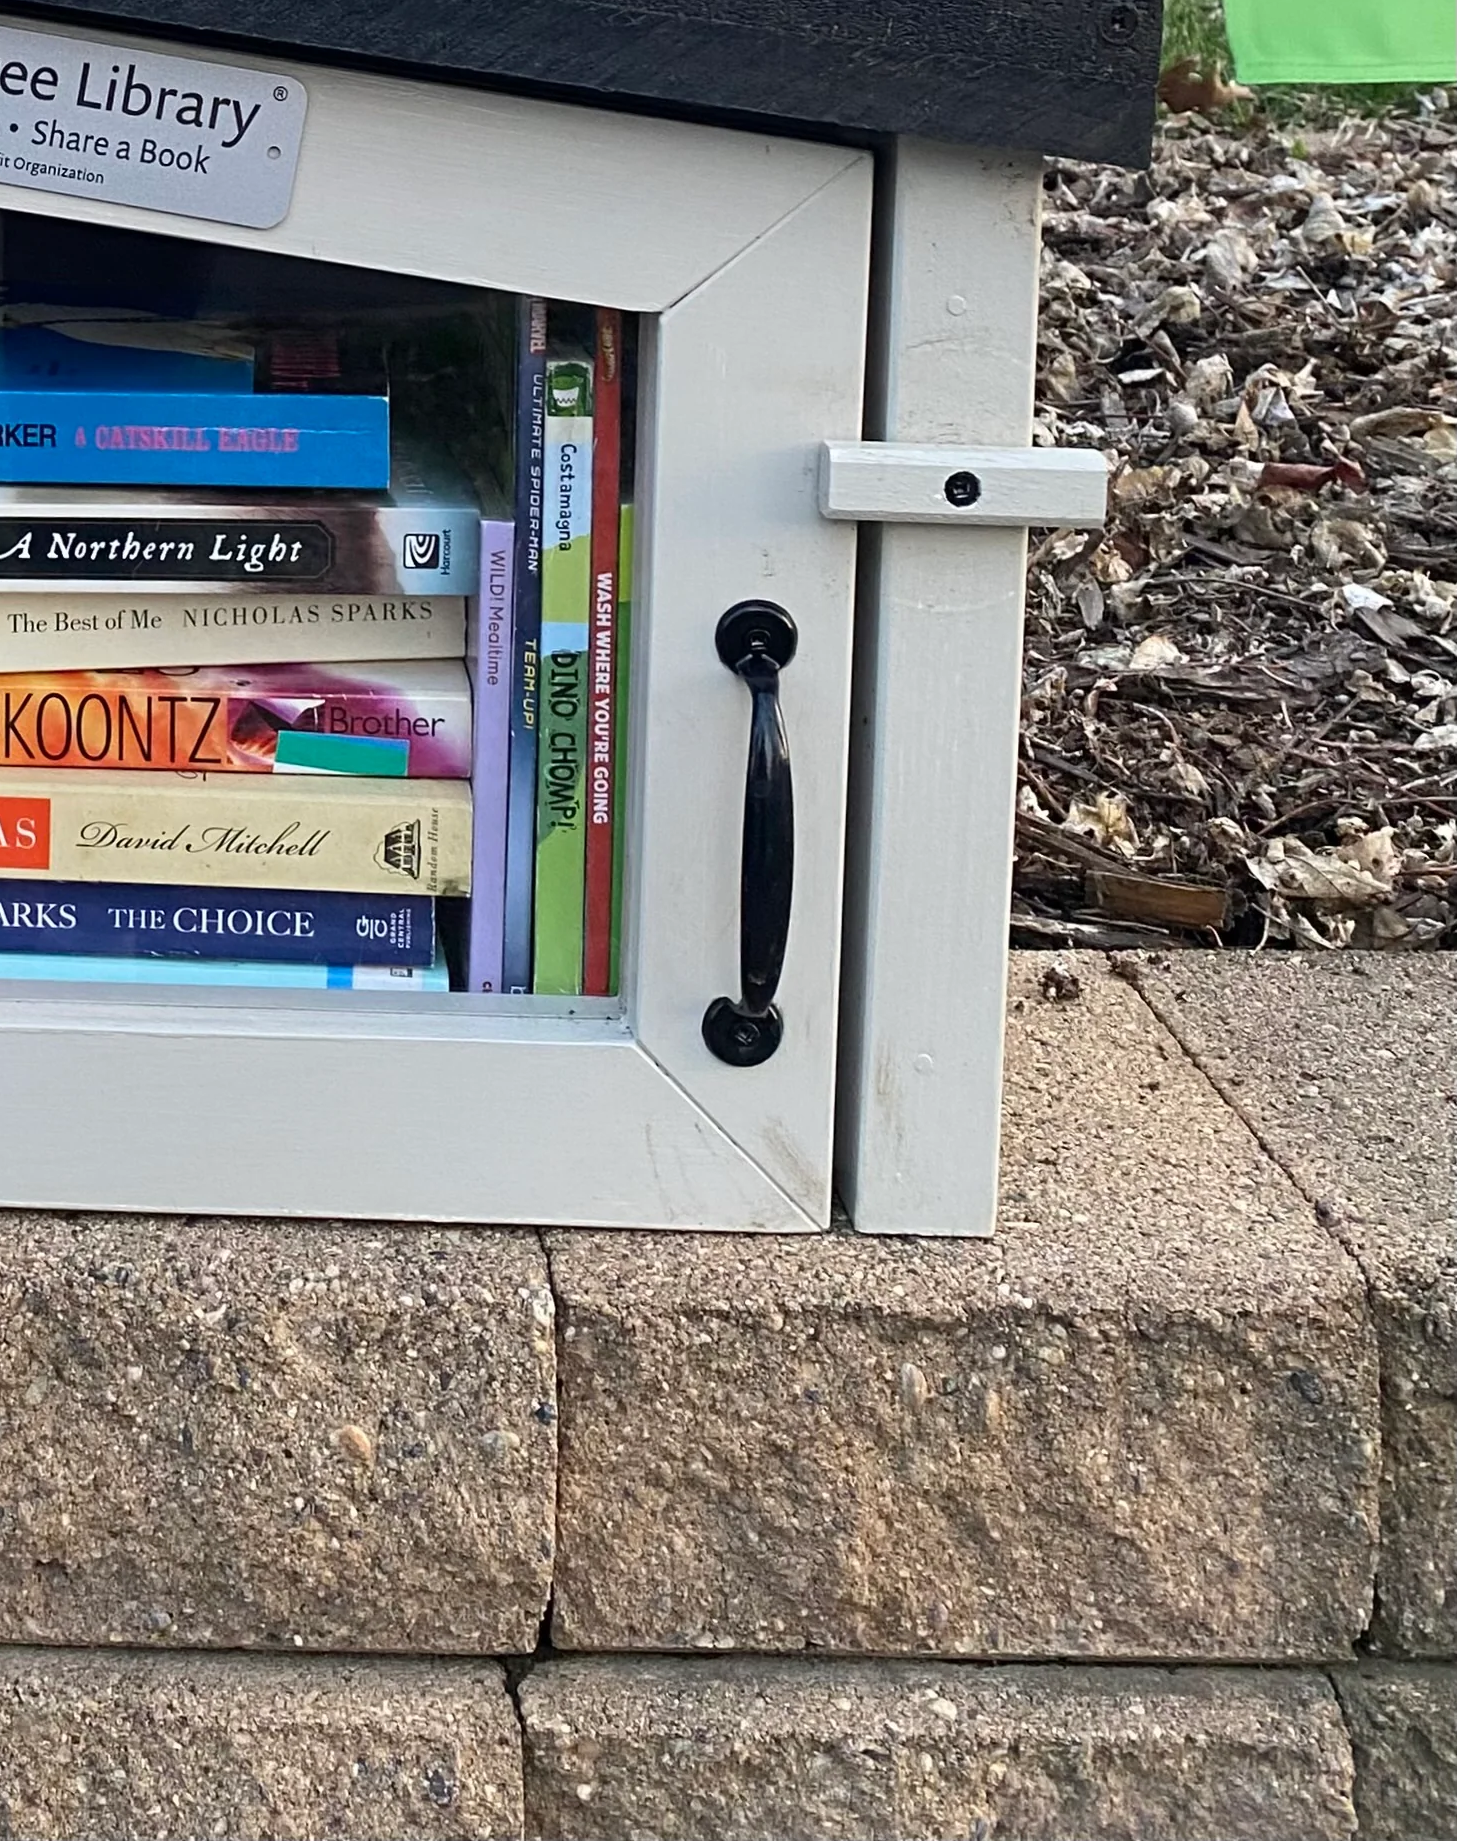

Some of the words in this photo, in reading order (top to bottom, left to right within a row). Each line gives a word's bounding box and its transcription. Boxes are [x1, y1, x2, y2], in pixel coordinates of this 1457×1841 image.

[13, 153, 105, 185] Organization
[31, 121, 112, 159] Share
[115, 140, 132, 161] a
[140, 138, 212, 175] Book
[74, 426, 87, 449] A
[95, 425, 211, 451] CATSKILL
[218, 426, 300, 453] EAGLE
[530, 374, 544, 459] ULTIMATE
[527, 465, 542, 572] SPIDER-MAN
[555, 443, 578, 552] Costamagna
[47, 531, 194, 561] Northern
[208, 533, 303, 573] Light
[440, 528, 452, 576] Harcourt
[7, 612, 48, 633] The
[53, 611, 98, 632] Best
[105, 610, 126, 630] of
[130, 609, 162, 630] Me
[183, 604, 320, 628] NICHOLAS
[331, 601, 434, 623] SPARKS
[596, 572, 613, 627] WASH
[487, 606, 505, 686] Mealtime
[594, 630, 612, 694] WHERE
[550, 648, 582, 720] DINO
[4, 692, 222, 764] KOONTZ
[329, 706, 445, 737] Brother
[593, 698, 611, 763] YOU'RE
[548, 732, 581, 833] CHOMP!
[593, 767, 609, 825] GOING
[76, 820, 191, 852] David
[185, 821, 332, 858] Mitchell
[426, 806, 440, 843] House
[426, 845, 440, 893] Random
[107, 908, 166, 930] THE
[173, 907, 315, 938] CHOICE
